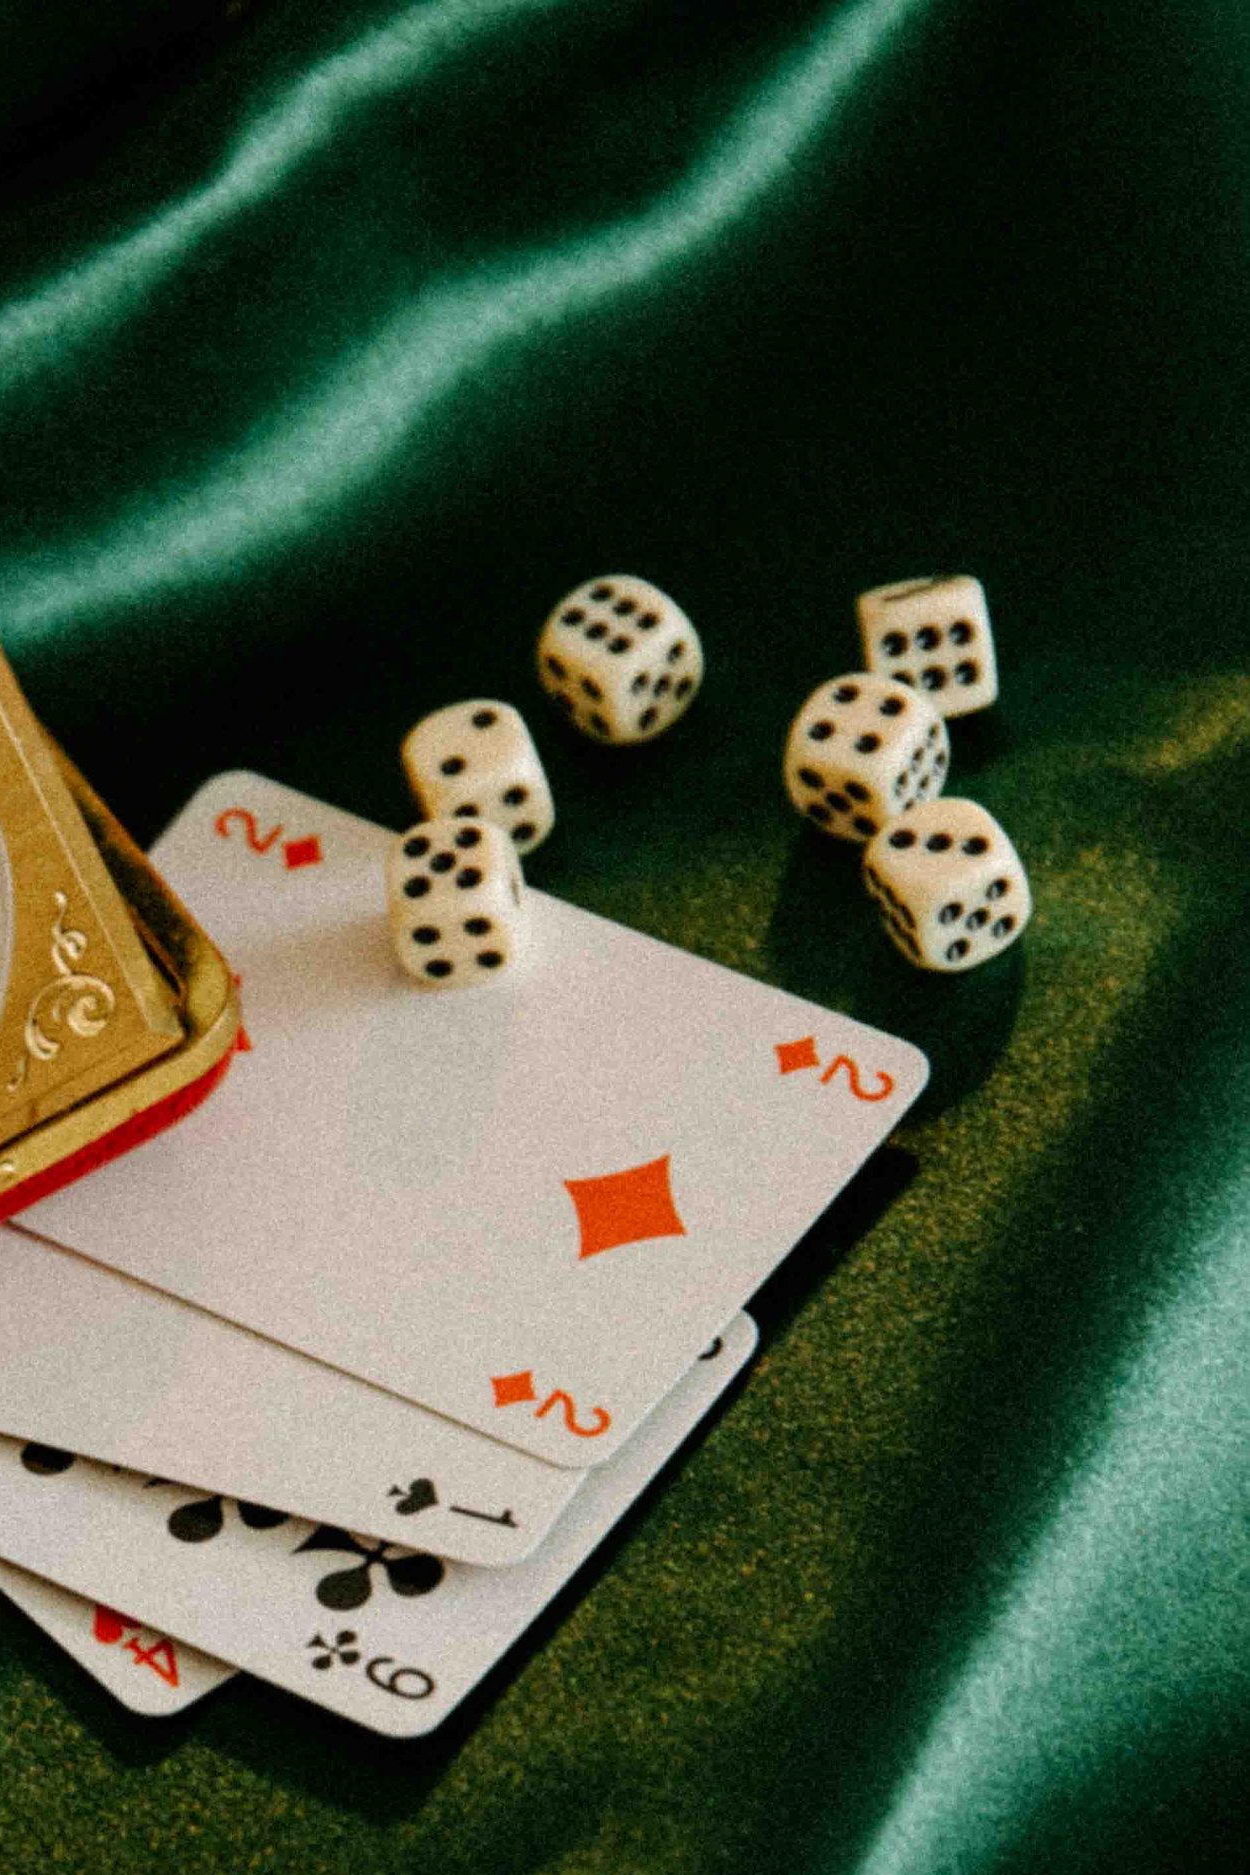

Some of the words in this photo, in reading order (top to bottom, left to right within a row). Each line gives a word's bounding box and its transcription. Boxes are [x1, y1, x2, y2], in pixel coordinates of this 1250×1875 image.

[215, 807, 282, 855] 2
[819, 1054, 895, 1103] 2
[534, 1388, 612, 1438] 2
[448, 1504, 519, 1530] 1
[123, 1636, 180, 1689] 4
